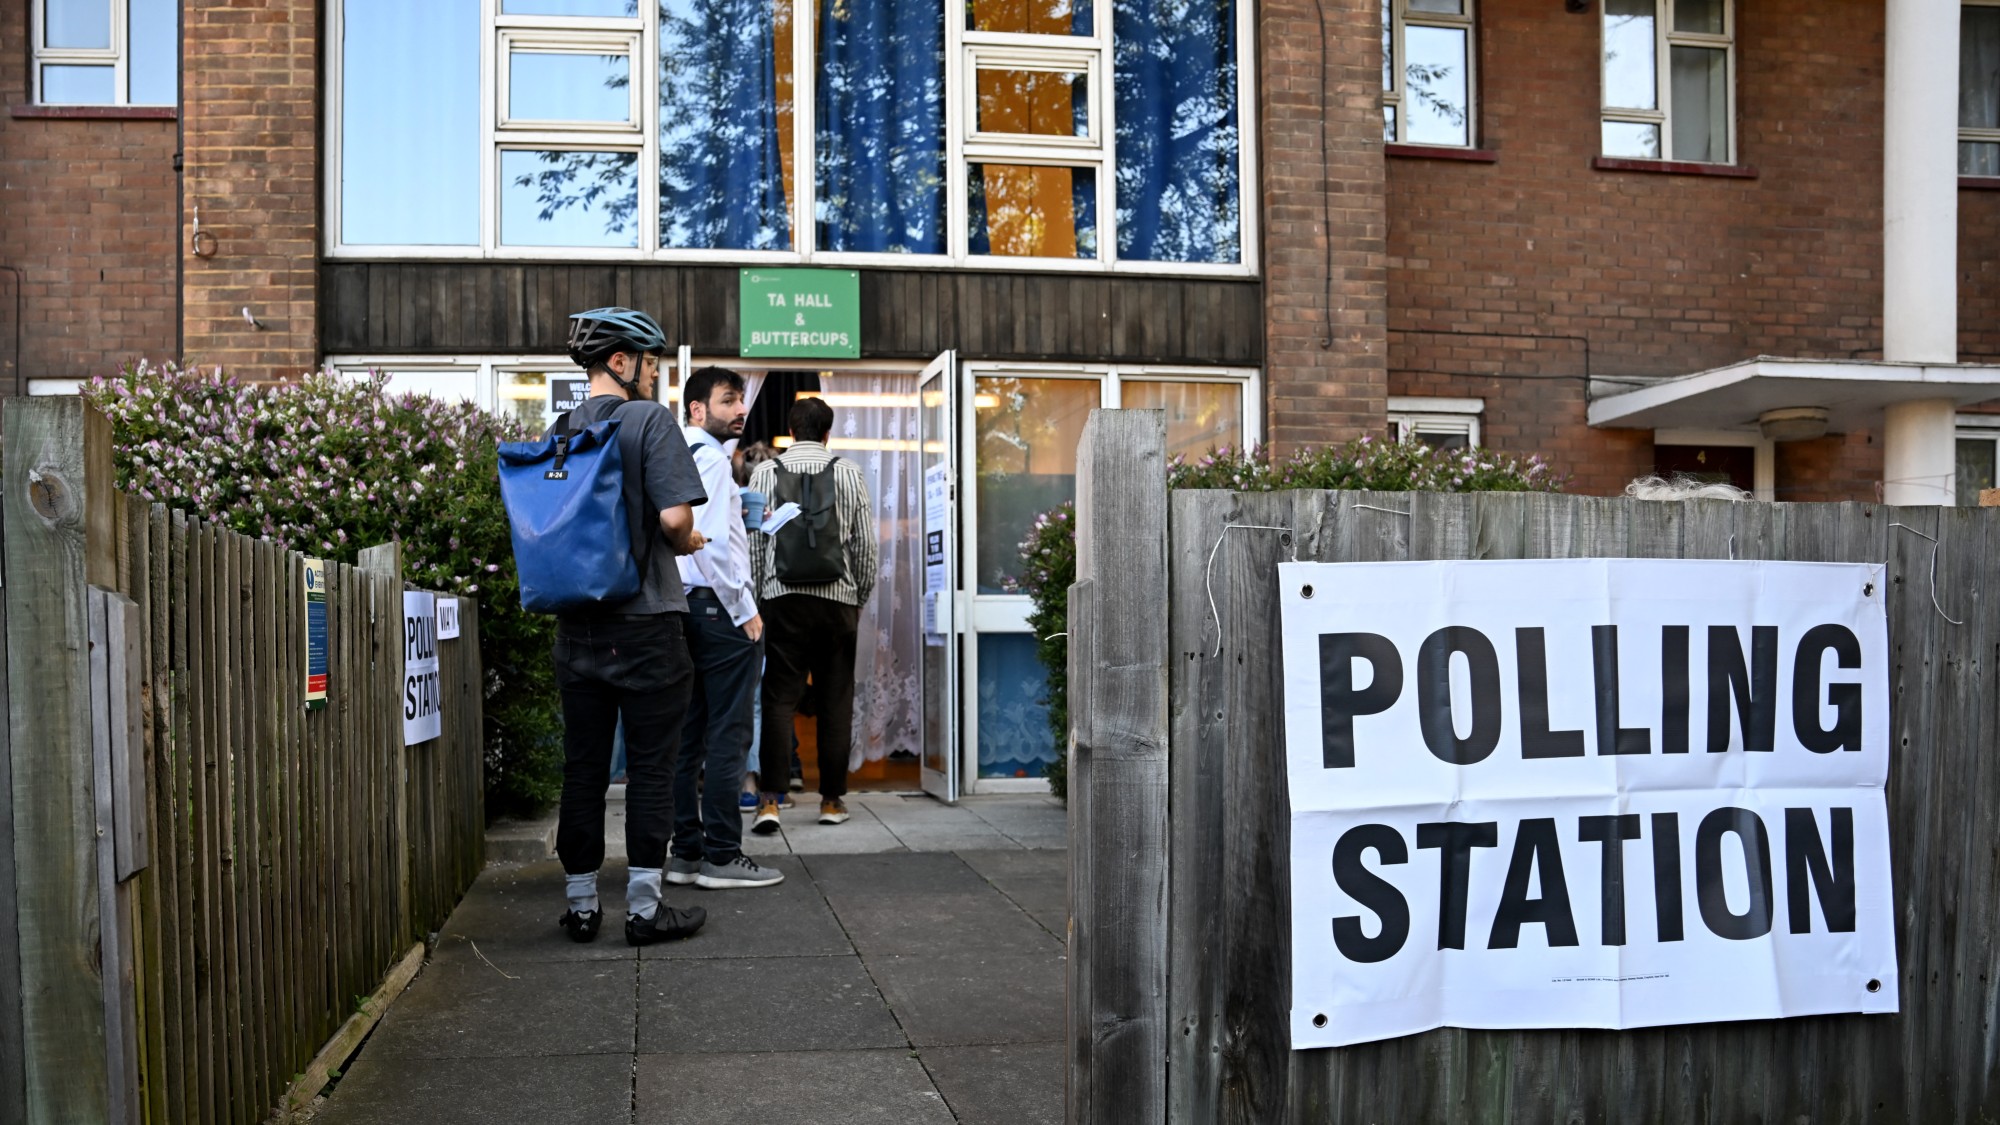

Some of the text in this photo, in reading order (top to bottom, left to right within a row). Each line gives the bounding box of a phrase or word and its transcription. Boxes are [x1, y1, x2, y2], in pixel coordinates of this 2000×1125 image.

[767, 293, 833, 307] TA HALL
[795, 312, 806, 326] &
[751, 331, 849, 346] BUTTERCUPS
[572, 391, 583, 400] TO
[1697, 450, 1706, 464] 4
[1318, 623, 1862, 769] POLLING
[1331, 806, 1856, 964] STATION
